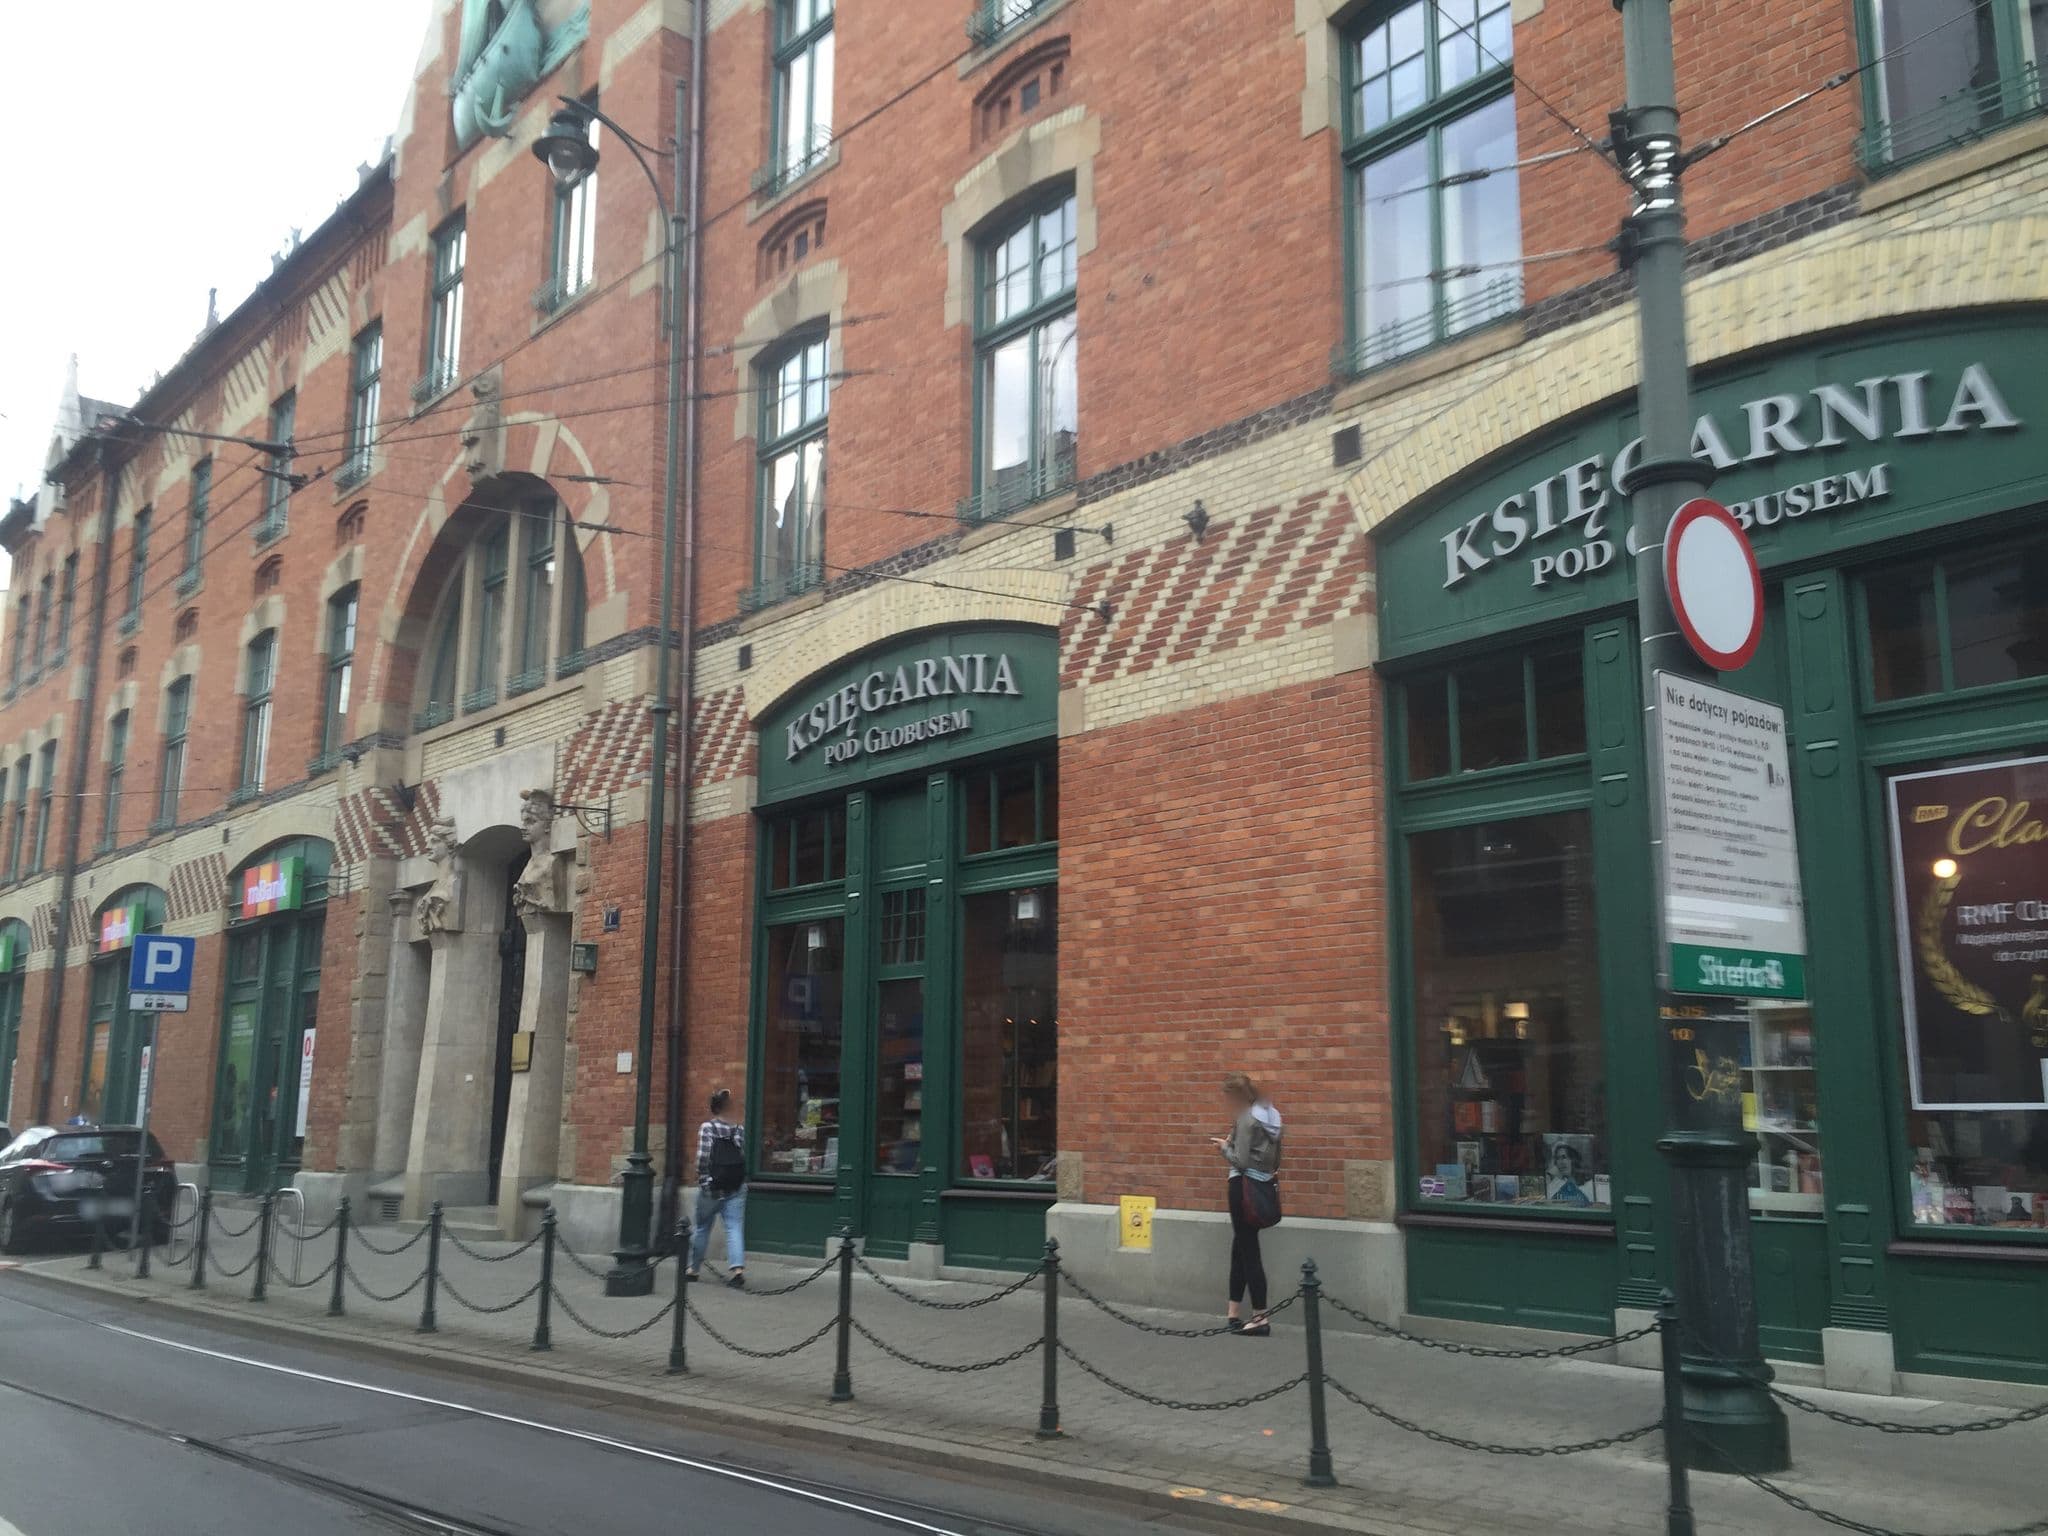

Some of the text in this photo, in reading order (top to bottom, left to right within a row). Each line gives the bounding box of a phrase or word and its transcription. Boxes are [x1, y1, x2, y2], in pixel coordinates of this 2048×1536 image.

[1530, 537, 1614, 588] POD
[785, 653, 1023, 761] KSIĘGARNIA
[1666, 686, 1685, 707] Nie
[1689, 694, 1728, 724] dotyczy
[824, 708, 974, 766] POD GLOBUSEM
[247, 873, 288, 905] mBank
[144, 941, 182, 985] P
